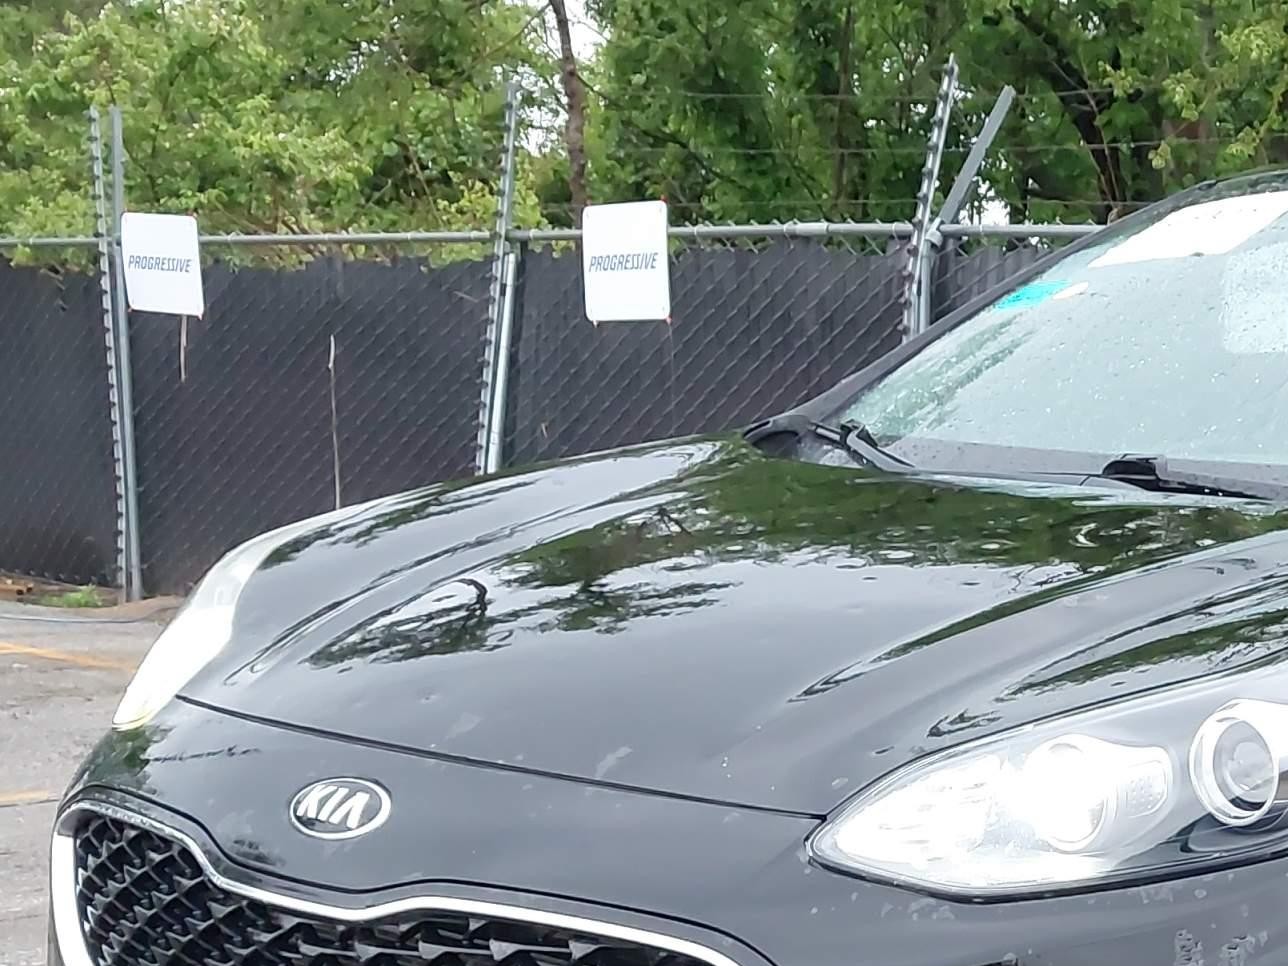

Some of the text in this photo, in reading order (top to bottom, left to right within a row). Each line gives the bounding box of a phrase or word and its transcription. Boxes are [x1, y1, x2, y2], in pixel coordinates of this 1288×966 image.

[128, 255, 192, 272] PROGRESSIVE
[589, 252, 659, 272] PROGRESSIVE
[295, 783, 371, 830] KIA
